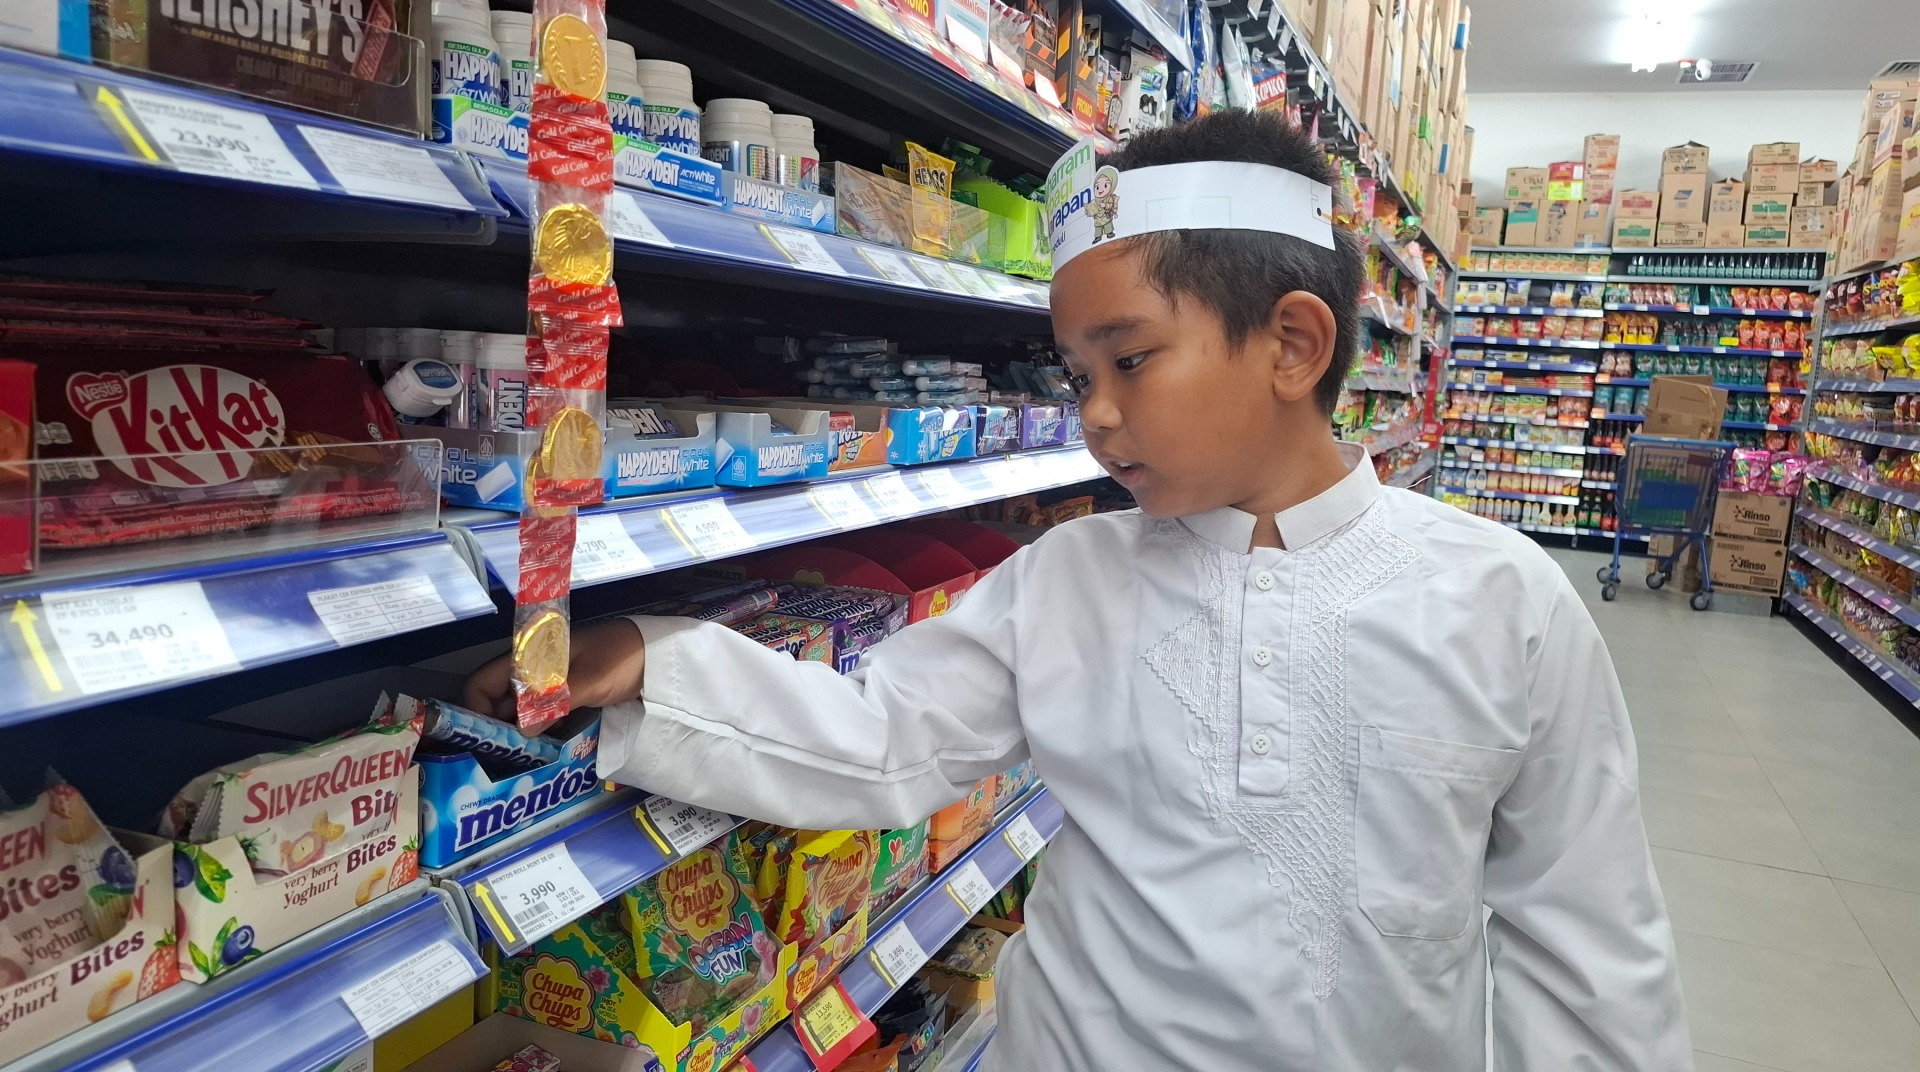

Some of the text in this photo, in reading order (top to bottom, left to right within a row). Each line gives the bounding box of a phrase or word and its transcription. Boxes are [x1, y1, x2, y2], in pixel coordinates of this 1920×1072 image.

[1254, 76, 1286, 103] KOPIKO
[1076, 96, 1093, 118] PROMO
[170, 127, 251, 153] 23,990
[537, 124, 577, 139] Gold Coin
[586, 135, 605, 146] Coin
[540, 148, 558, 160] Coin
[551, 160, 589, 176] Gold Coin
[581, 174, 600, 187] Gold
[625, 150, 680, 187] HAPPYDENT
[733, 178, 786, 215] HAPPYDENT
[558, 286, 602, 303] Gold Coin
[560, 368, 573, 382] Gold
[573, 361, 588, 374] Coin
[581, 374, 597, 389] Gold
[74, 380, 125, 406] Nestlé
[107, 366, 281, 486] KitKat
[617, 448, 681, 480] HAPPYDENT
[757, 443, 805, 470] HAPPYDENT
[418, 461, 479, 486] White
[1744, 508, 1771, 523] Rinso
[1740, 557, 1767, 572] Rinso
[550, 582, 561, 598] Gold
[694, 604, 729, 621] entos
[87, 623, 175, 649] 34,490
[351, 787, 401, 827] Bit
[456, 761, 599, 850] mentos
[460, 799, 484, 812] CHEWY
[669, 806, 698, 827] 3,990
[346, 833, 398, 875] Bites
[888, 827, 920, 868] Yupi
[284, 858, 341, 892] very berry
[491, 871, 514, 886] MENTOS
[513, 864, 528, 876] ROLL
[526, 859, 541, 870] MINT
[547, 852, 556, 861] GR
[665, 854, 716, 895] Chupa
[824, 848, 864, 881] Chupa
[282, 872, 341, 911] Yoghurt
[519, 880, 557, 907] 3,990
[670, 878, 726, 930] Chups
[13, 904, 84, 945] very berry
[22, 922, 95, 966] Yoghurt
[687, 913, 754, 978] OCEAN
[69, 930, 146, 988] Bites
[709, 949, 744, 982] FUN
[530, 972, 585, 1002] Chupa
[528, 991, 584, 1029] Chups
[677, 1045, 692, 1063] BARU
